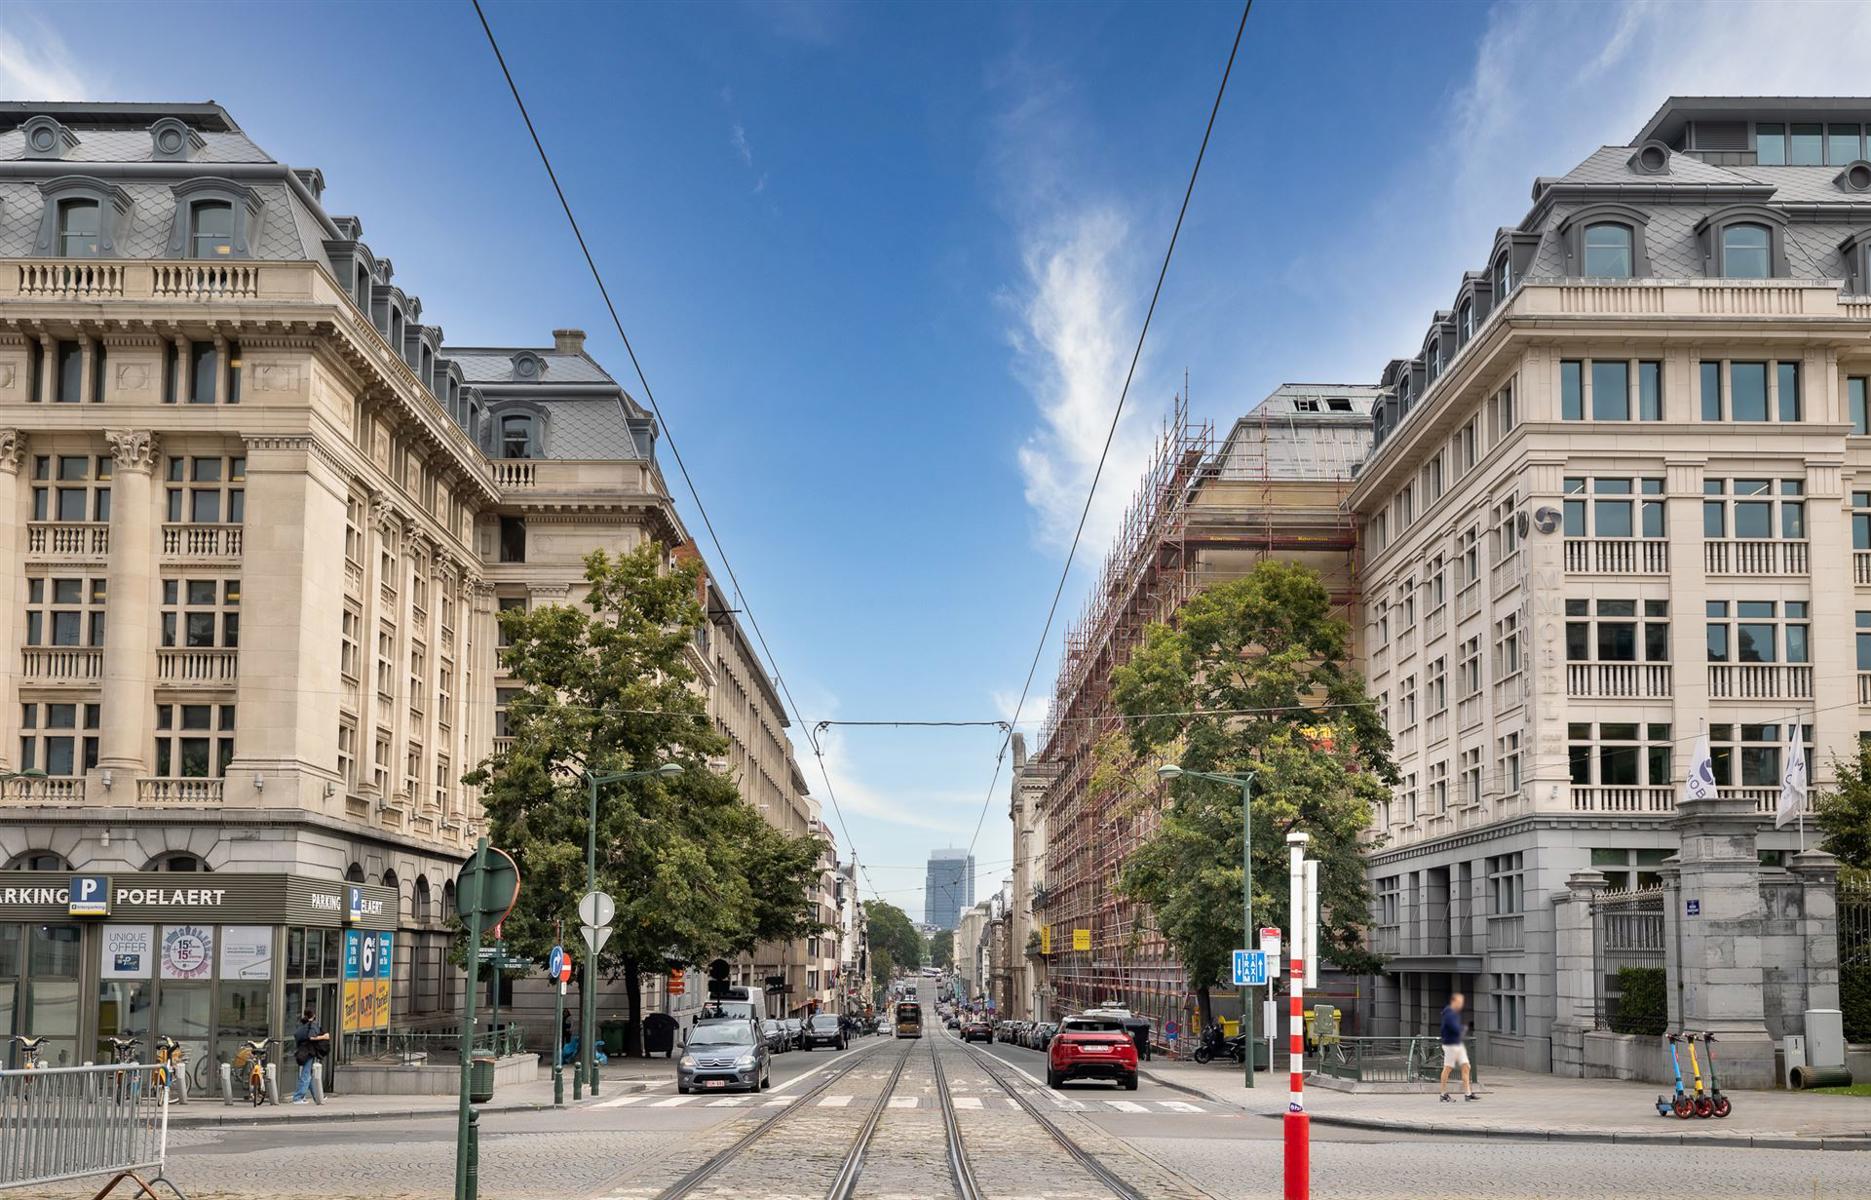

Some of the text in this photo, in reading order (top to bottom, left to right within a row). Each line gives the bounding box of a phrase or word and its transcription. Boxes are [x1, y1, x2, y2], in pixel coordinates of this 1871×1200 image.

[0, 888, 225, 905] RKING POELAERT
[81, 879, 97, 901] P
[312, 893, 383, 915] PARKING ELAERT
[109, 933, 147, 942] UNIQUE
[108, 943, 147, 952] OFFER
